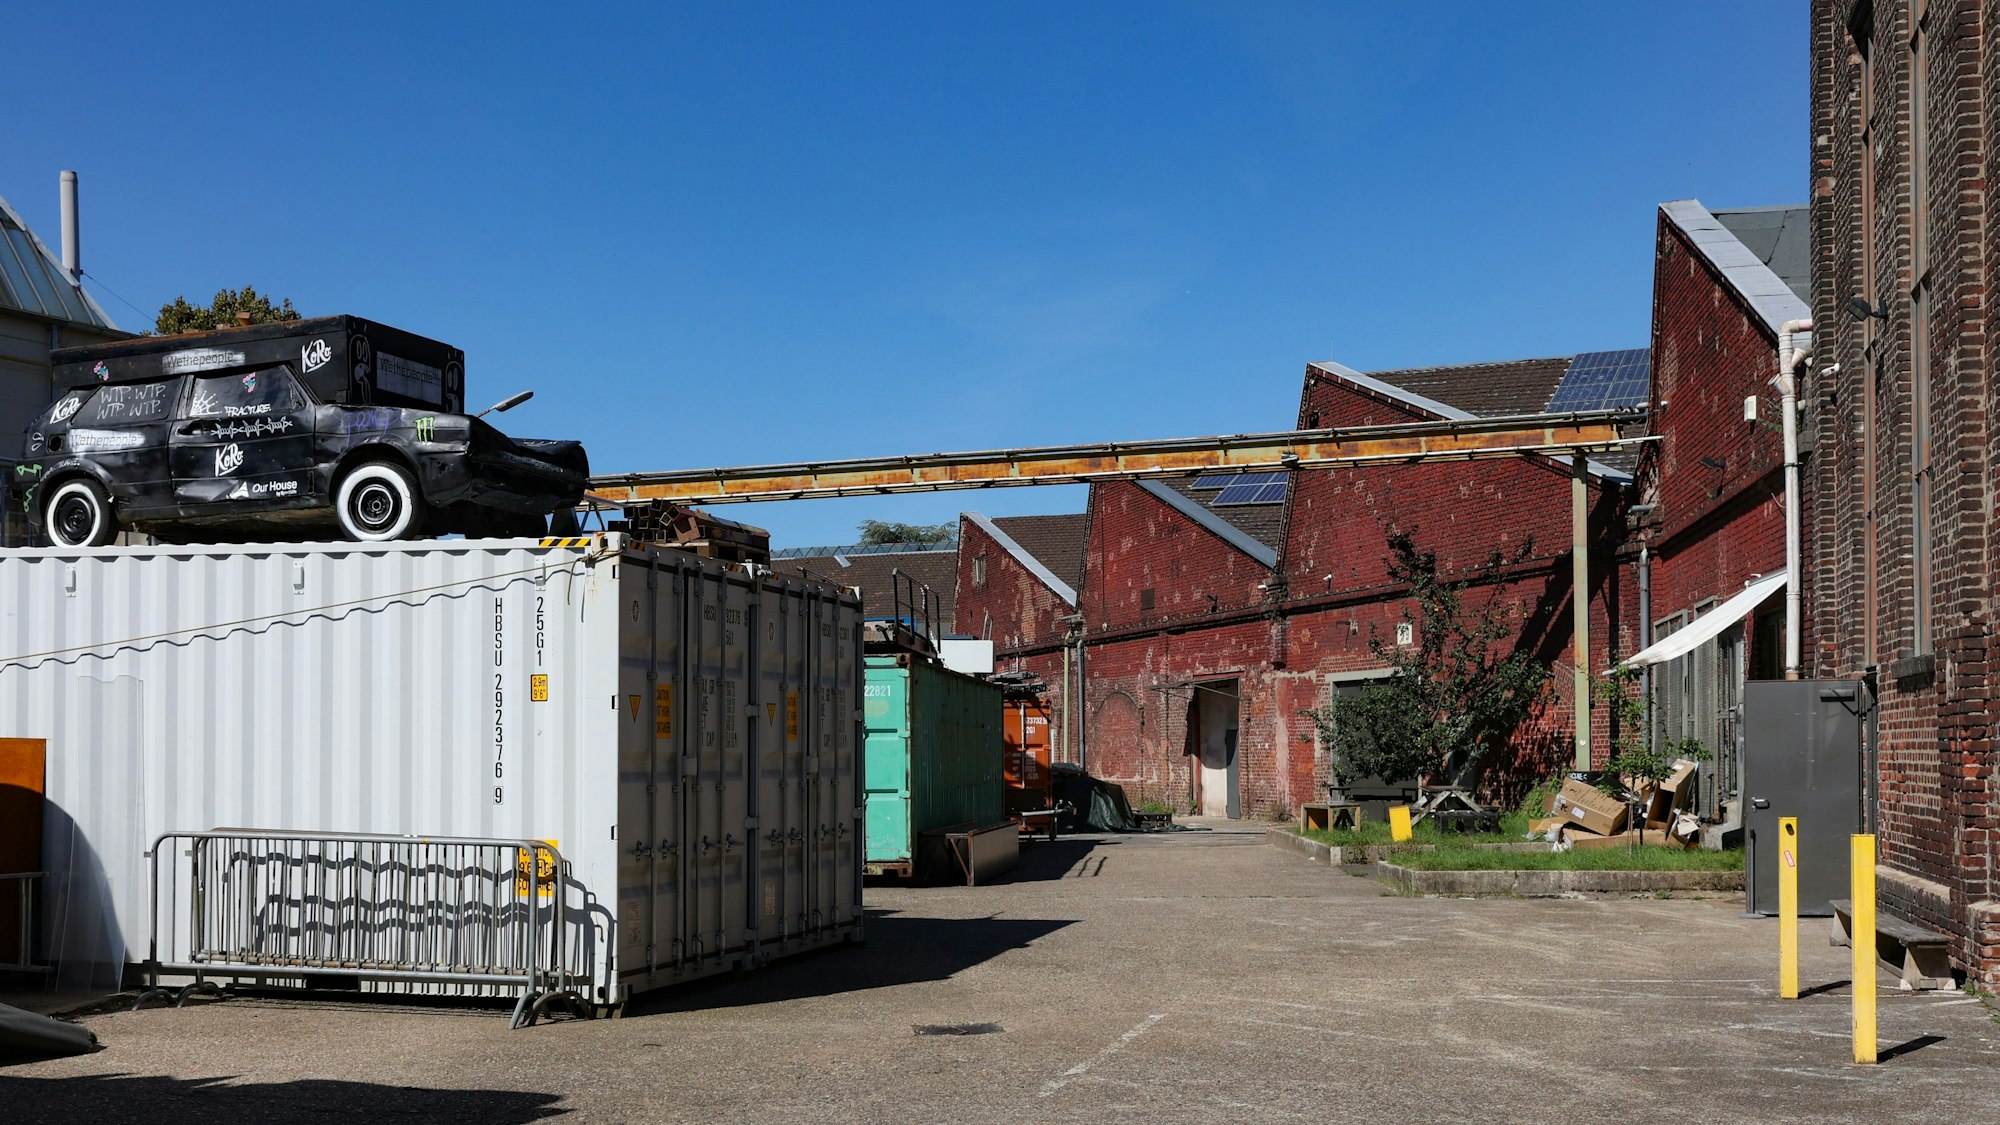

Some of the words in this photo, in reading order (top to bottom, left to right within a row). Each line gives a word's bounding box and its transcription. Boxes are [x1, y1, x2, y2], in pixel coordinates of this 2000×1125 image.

[165, 352, 234, 369] Wethepeople
[252, 483, 269, 493] Our
[269, 480, 298, 492] House
[703, 604, 717, 622] HBSU
[725, 608, 741, 625] 92376
[494, 597, 503, 667] HBSU
[536, 596, 544, 666] 25G1
[725, 630, 734, 646] 5G1
[495, 673, 503, 779] 292376
[1026, 716, 1043, 725] 73732
[1026, 726, 1036, 734] 2G1
